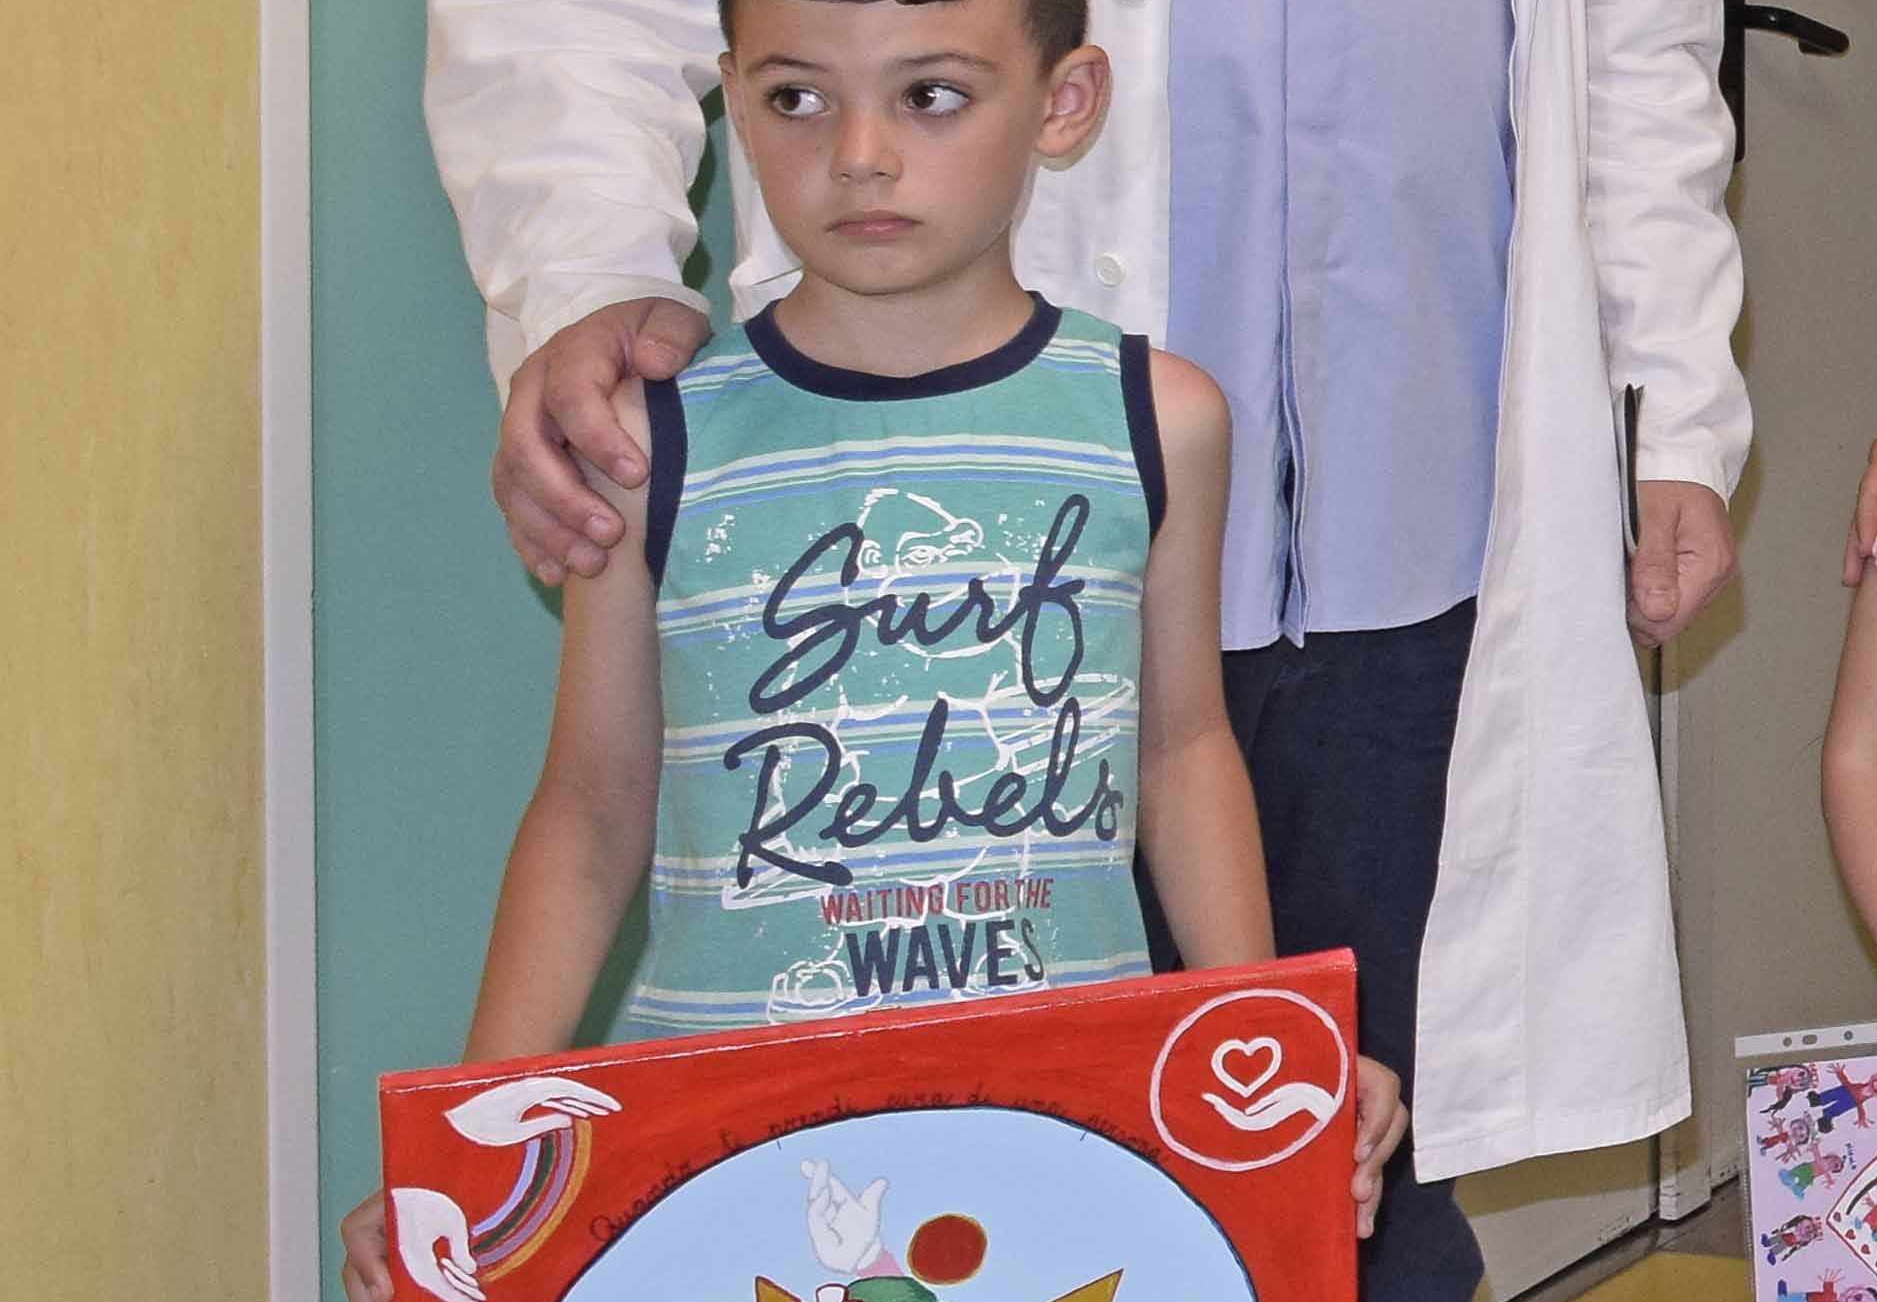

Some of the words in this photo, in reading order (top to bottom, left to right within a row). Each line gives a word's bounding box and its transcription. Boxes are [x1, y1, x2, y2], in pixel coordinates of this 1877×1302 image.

[750, 494, 1090, 715] Surf
[723, 697, 1124, 888] Rebels
[822, 883, 942, 925] WAITING
[954, 879, 1011, 912] FOR
[1012, 877, 1052, 910] THE
[845, 918, 1045, 997] WAVES
